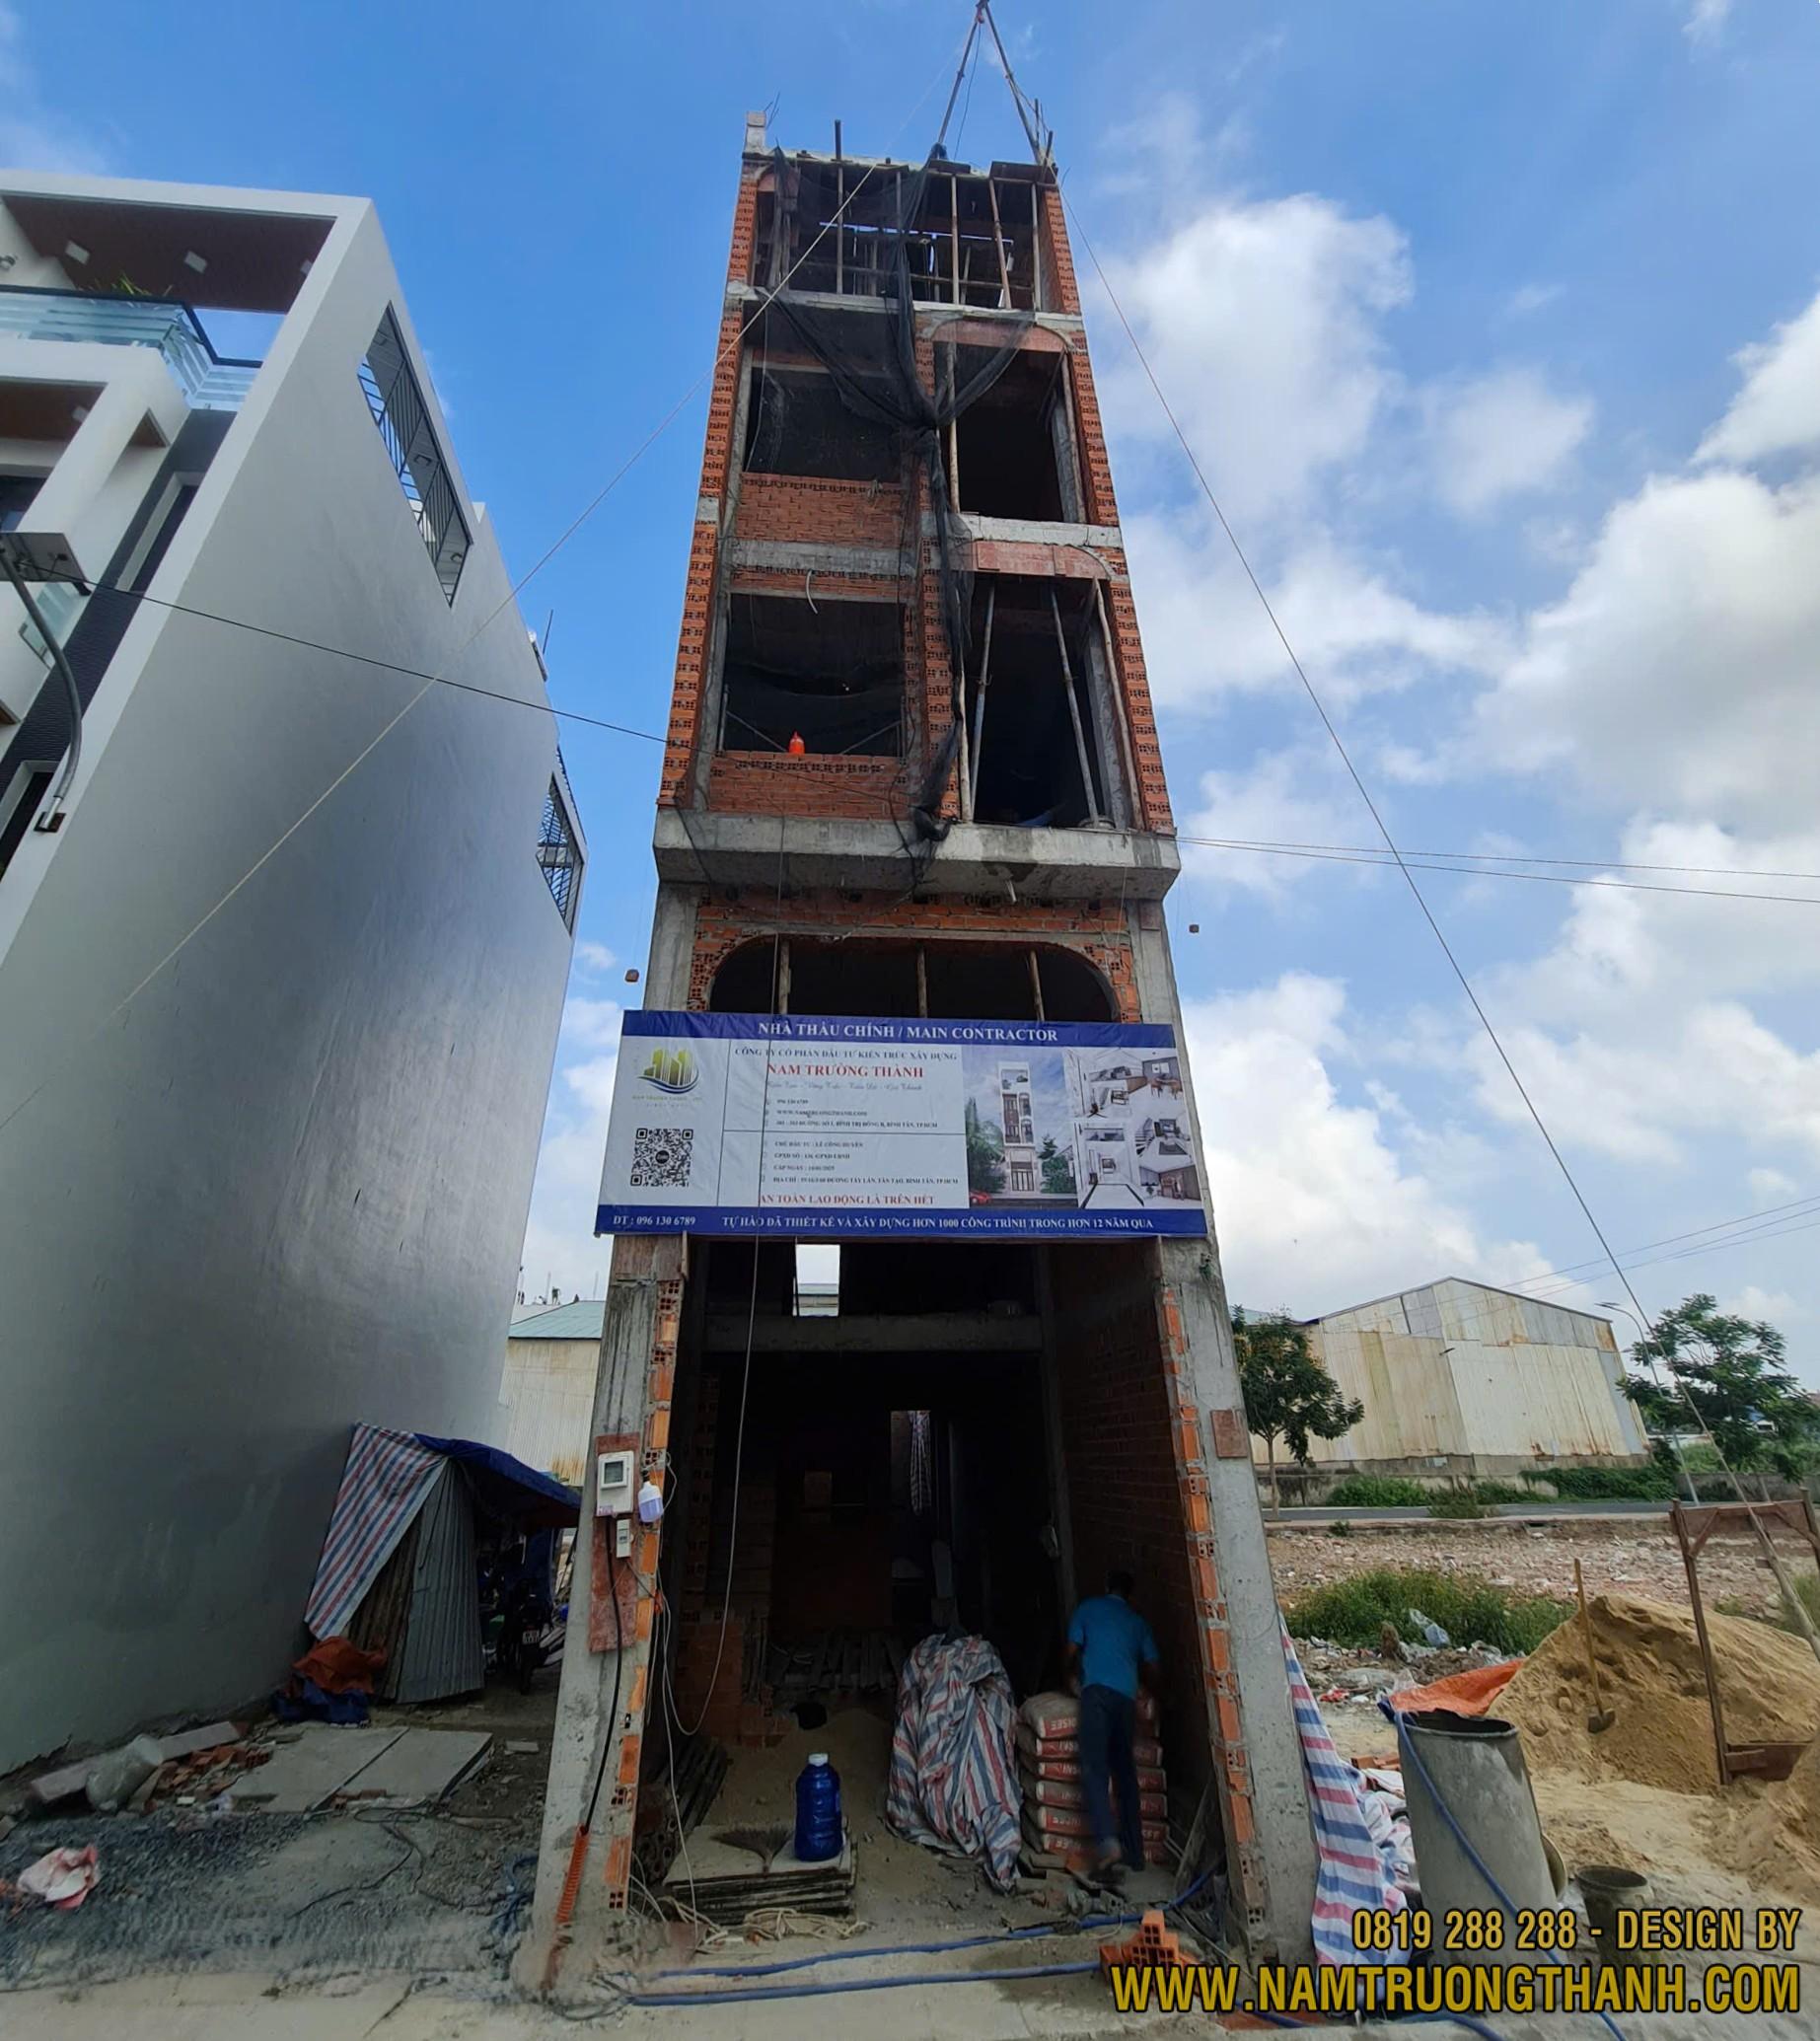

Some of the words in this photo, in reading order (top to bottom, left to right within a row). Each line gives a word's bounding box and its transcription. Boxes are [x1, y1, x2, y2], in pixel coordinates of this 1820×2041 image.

[758, 1021, 791, 1035] NHÀ
[843, 1022, 894, 1037] CHÍNH
[908, 1026, 947, 1039] MAIN
[952, 1027, 1058, 1041] CONTRACTOR
[735, 1047, 762, 1057] CÔNG
[910, 1051, 927, 1060] XÂY
[930, 1052, 957, 1061] DỰNG
[767, 1064, 800, 1075] NAM
[805, 1062, 868, 1076] TRƯỜNG
[874, 1063, 923, 1078] THÀNH
[762, 1195, 774, 1203] AN
[778, 1193, 805, 1203] TOÀN
[809, 1195, 831, 1203] LAO
[867, 1193, 880, 1204] LÀ
[884, 1193, 911, 1204] TRÊN
[636, 1216, 653, 1225] 096
[655, 1216, 671, 1225] 130
[674, 1216, 695, 1225] 6789
[722, 1216, 739, 1228] TỰ
[741, 1215, 764, 1227] HÀO
[784, 1215, 817, 1227] THIẾT
[820, 1215, 835, 1227] KẾ
[837, 1216, 852, 1227] VÀ
[855, 1216, 876, 1228] XÂY
[879, 1217, 910, 1230] DỰNG
[913, 1217, 936, 1228] HƠN
[939, 1218, 959, 1228] 1000
[961, 1216, 991, 1228] CÔNG
[993, 1217, 1026, 1228] TRÌNH
[1030, 1218, 1065, 1228] TRONG
[1068, 1217, 1090, 1228] HƠN
[1093, 1219, 1102, 1228] 12
[1105, 1217, 1129, 1228] NĂM
[1131, 1219, 1153, 1230] QUA
